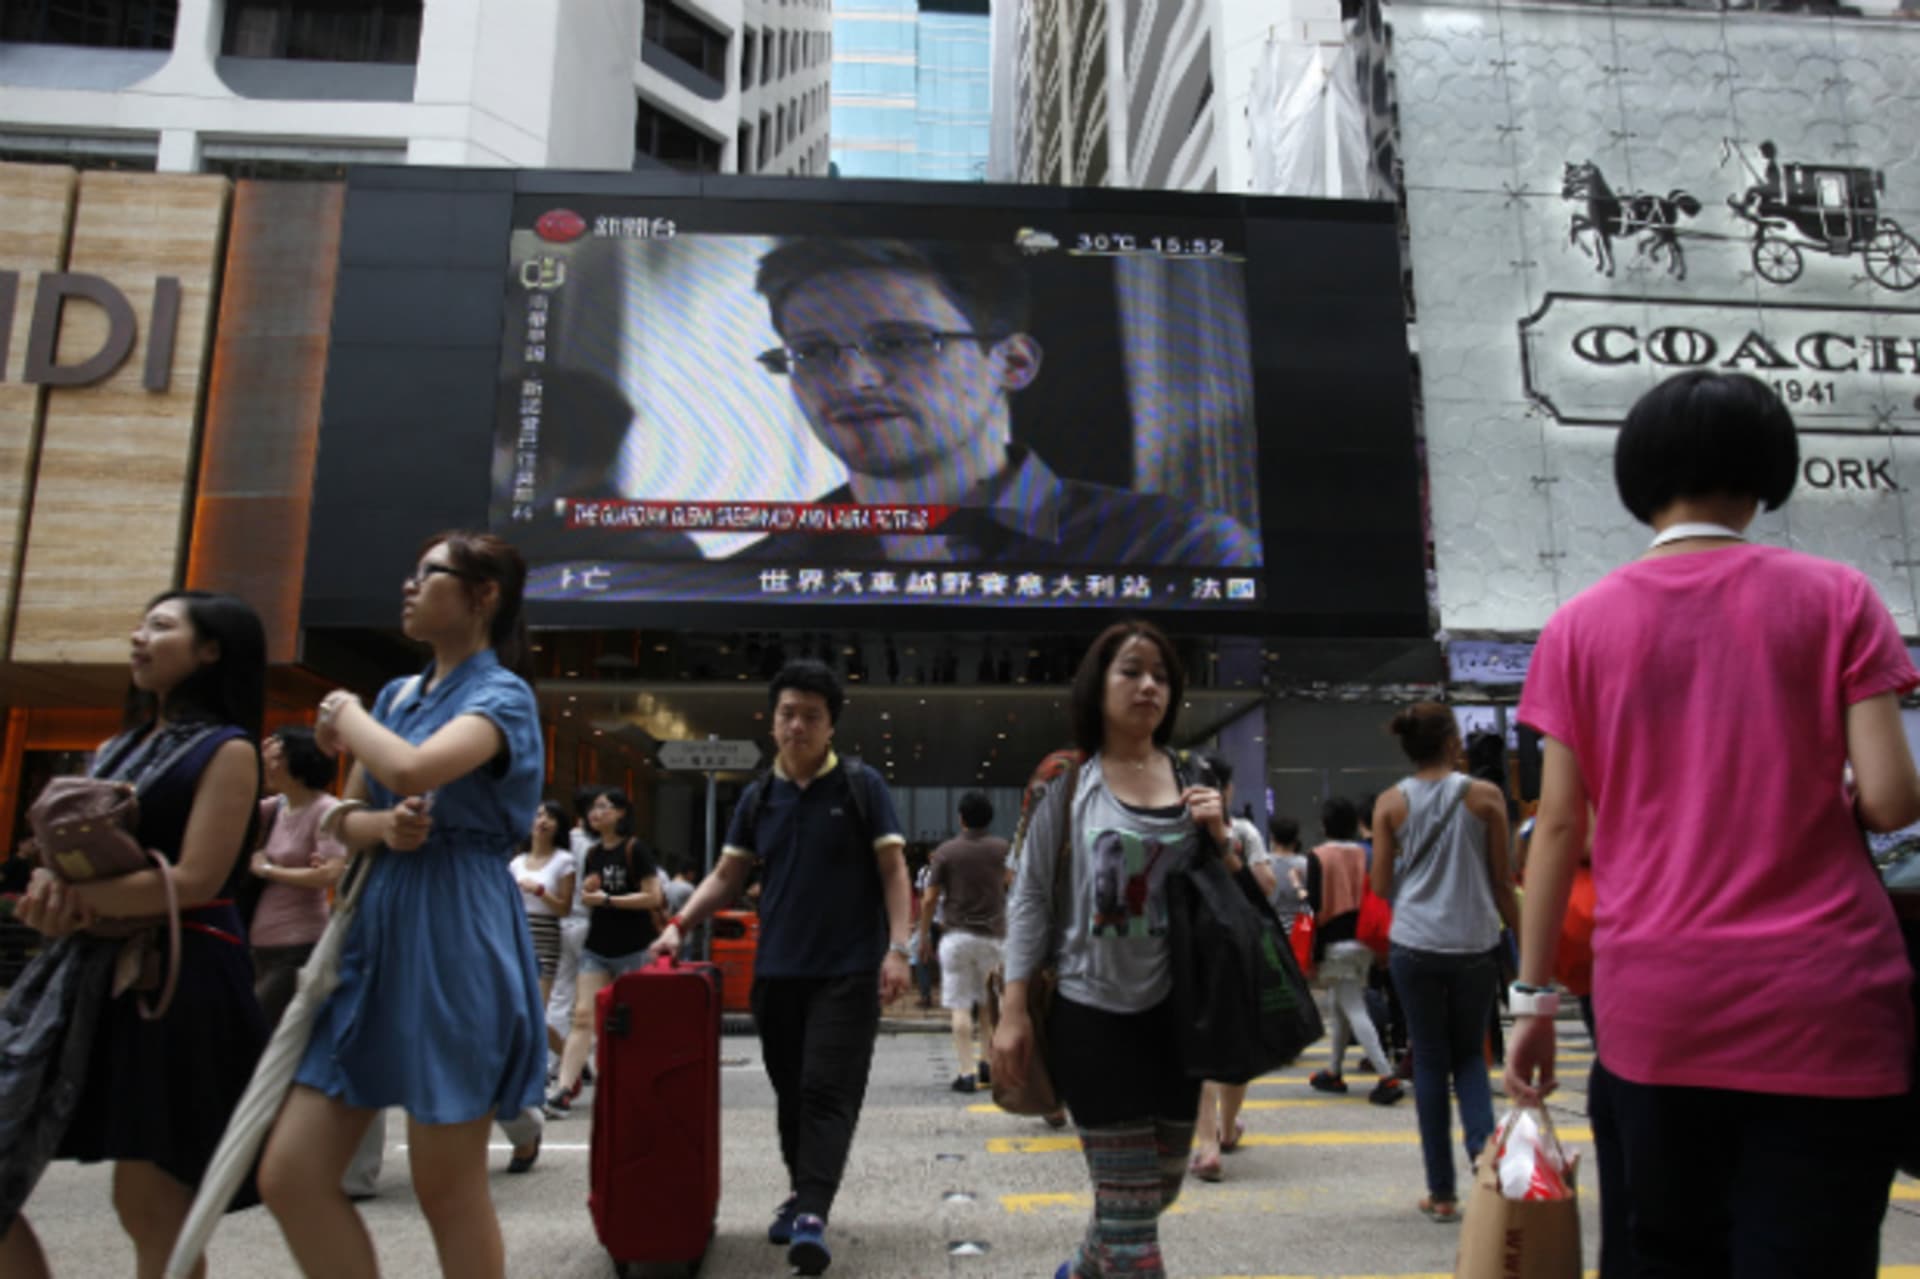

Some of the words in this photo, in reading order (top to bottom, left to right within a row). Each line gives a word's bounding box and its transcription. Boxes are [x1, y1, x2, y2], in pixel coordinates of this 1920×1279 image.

[1151, 237, 1225, 254] 15:52
[0, 270, 182, 393] DI
[1571, 325, 1920, 375] COACH
[1803, 456, 1898, 490] ORK
